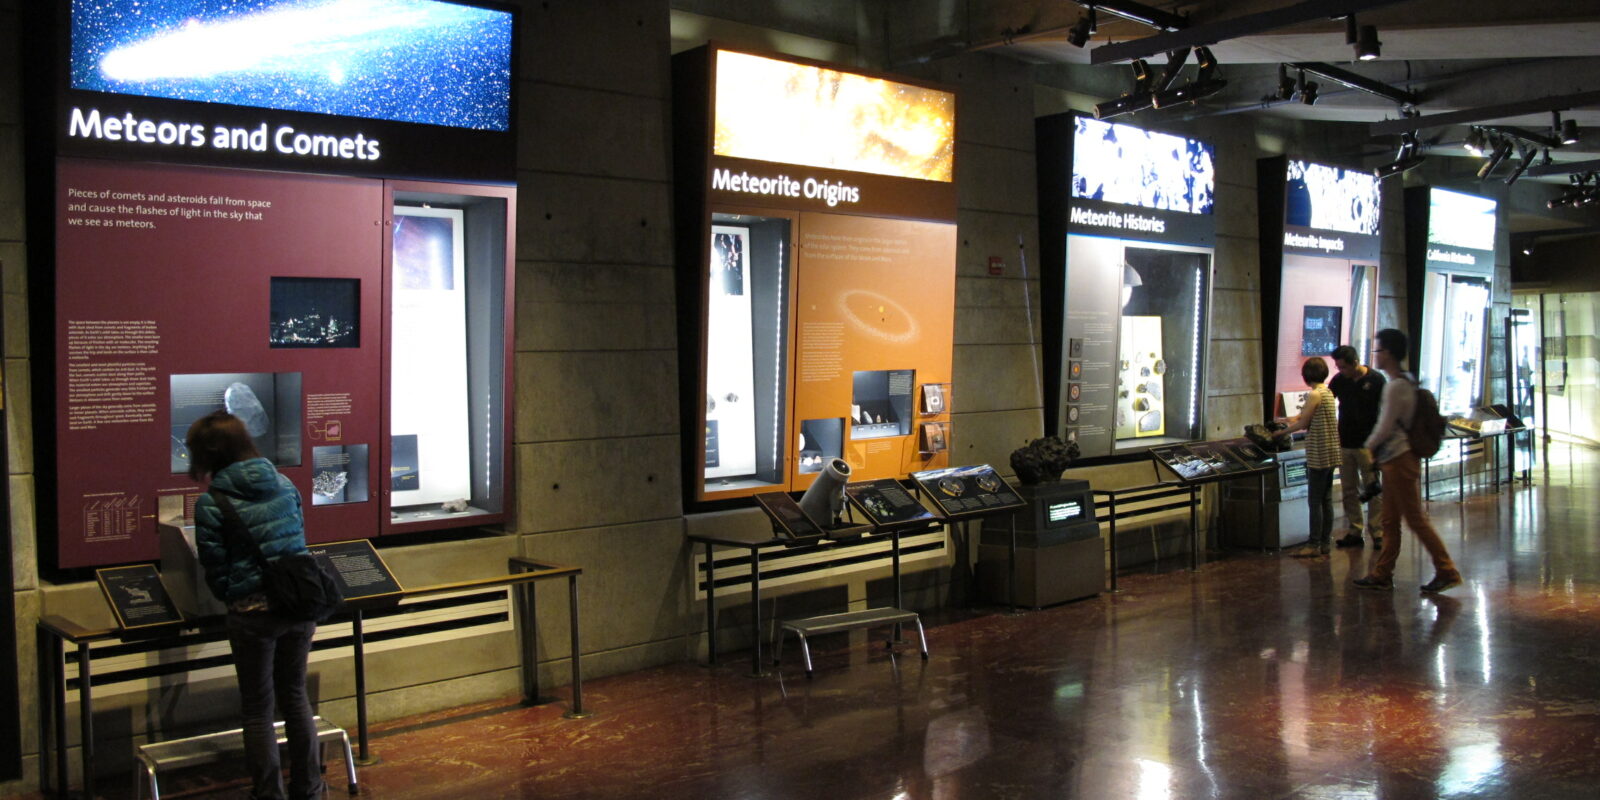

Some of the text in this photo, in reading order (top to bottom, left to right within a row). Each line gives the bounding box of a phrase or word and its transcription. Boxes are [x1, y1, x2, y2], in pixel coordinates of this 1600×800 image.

[68, 106, 381, 161] Meteors and Comets
[712, 167, 860, 207] Meteorite Origins
[68, 188, 272, 209] Pieces of comets and asteroids fall from space
[68, 203, 264, 222] and cause the flashes of light in the sky that
[1070, 206, 1166, 233] Meteorite Histories
[116, 220, 157, 229] meteors.
[1284, 232, 1345, 254] Meteorite Impacts
